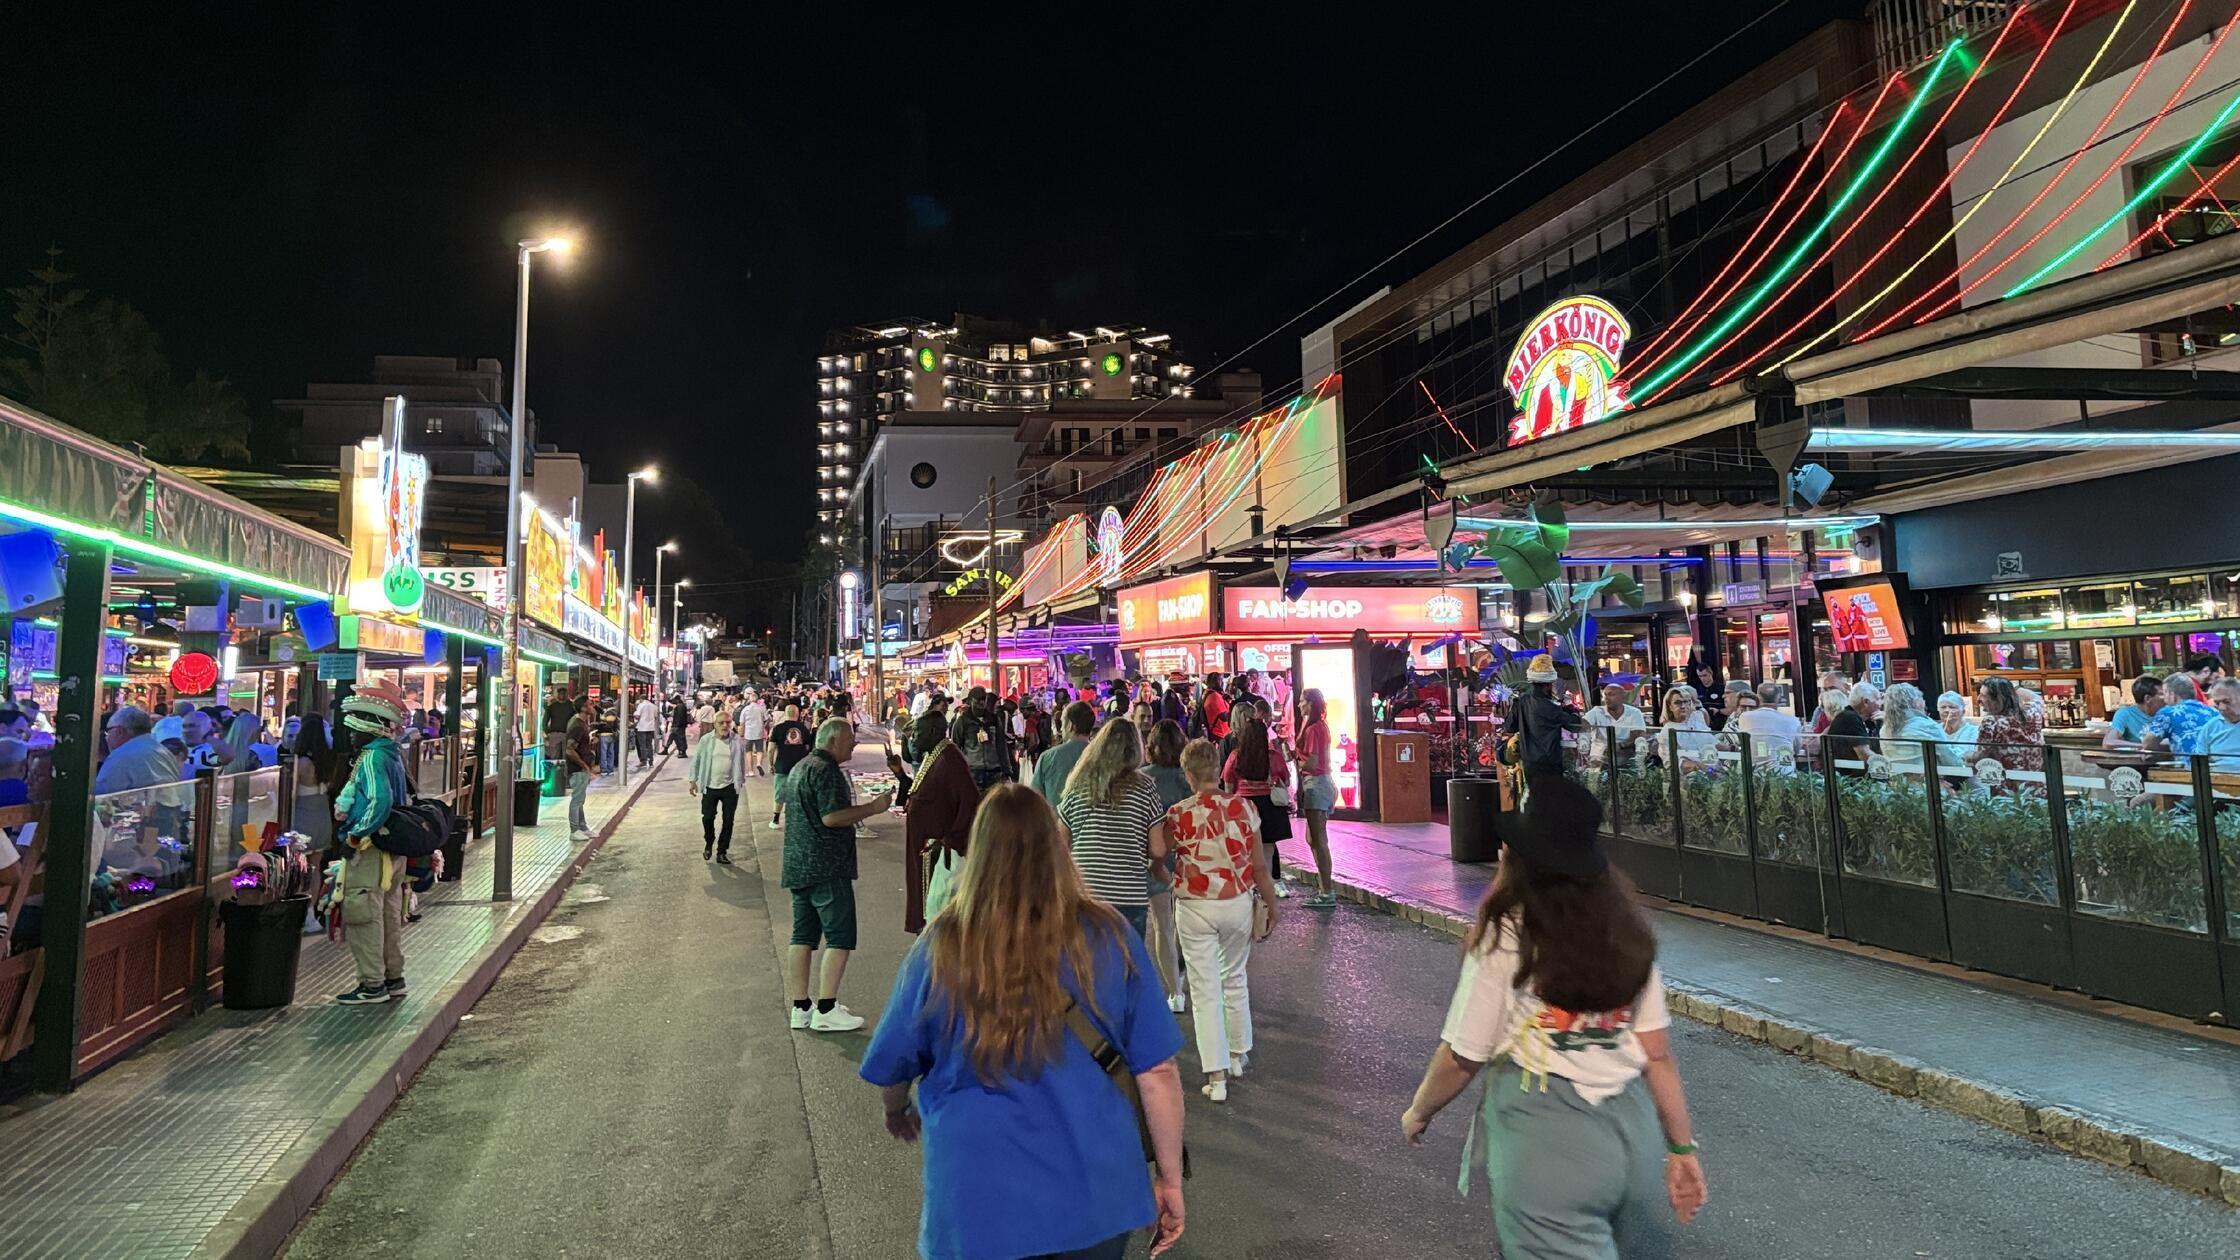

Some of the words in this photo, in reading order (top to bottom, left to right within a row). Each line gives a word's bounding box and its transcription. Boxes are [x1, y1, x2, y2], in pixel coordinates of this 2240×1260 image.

[1508, 303, 1620, 393] BIERKÖNIG
[945, 567, 979, 597] SAN
[1238, 599, 1363, 619] FAN-SHOP
